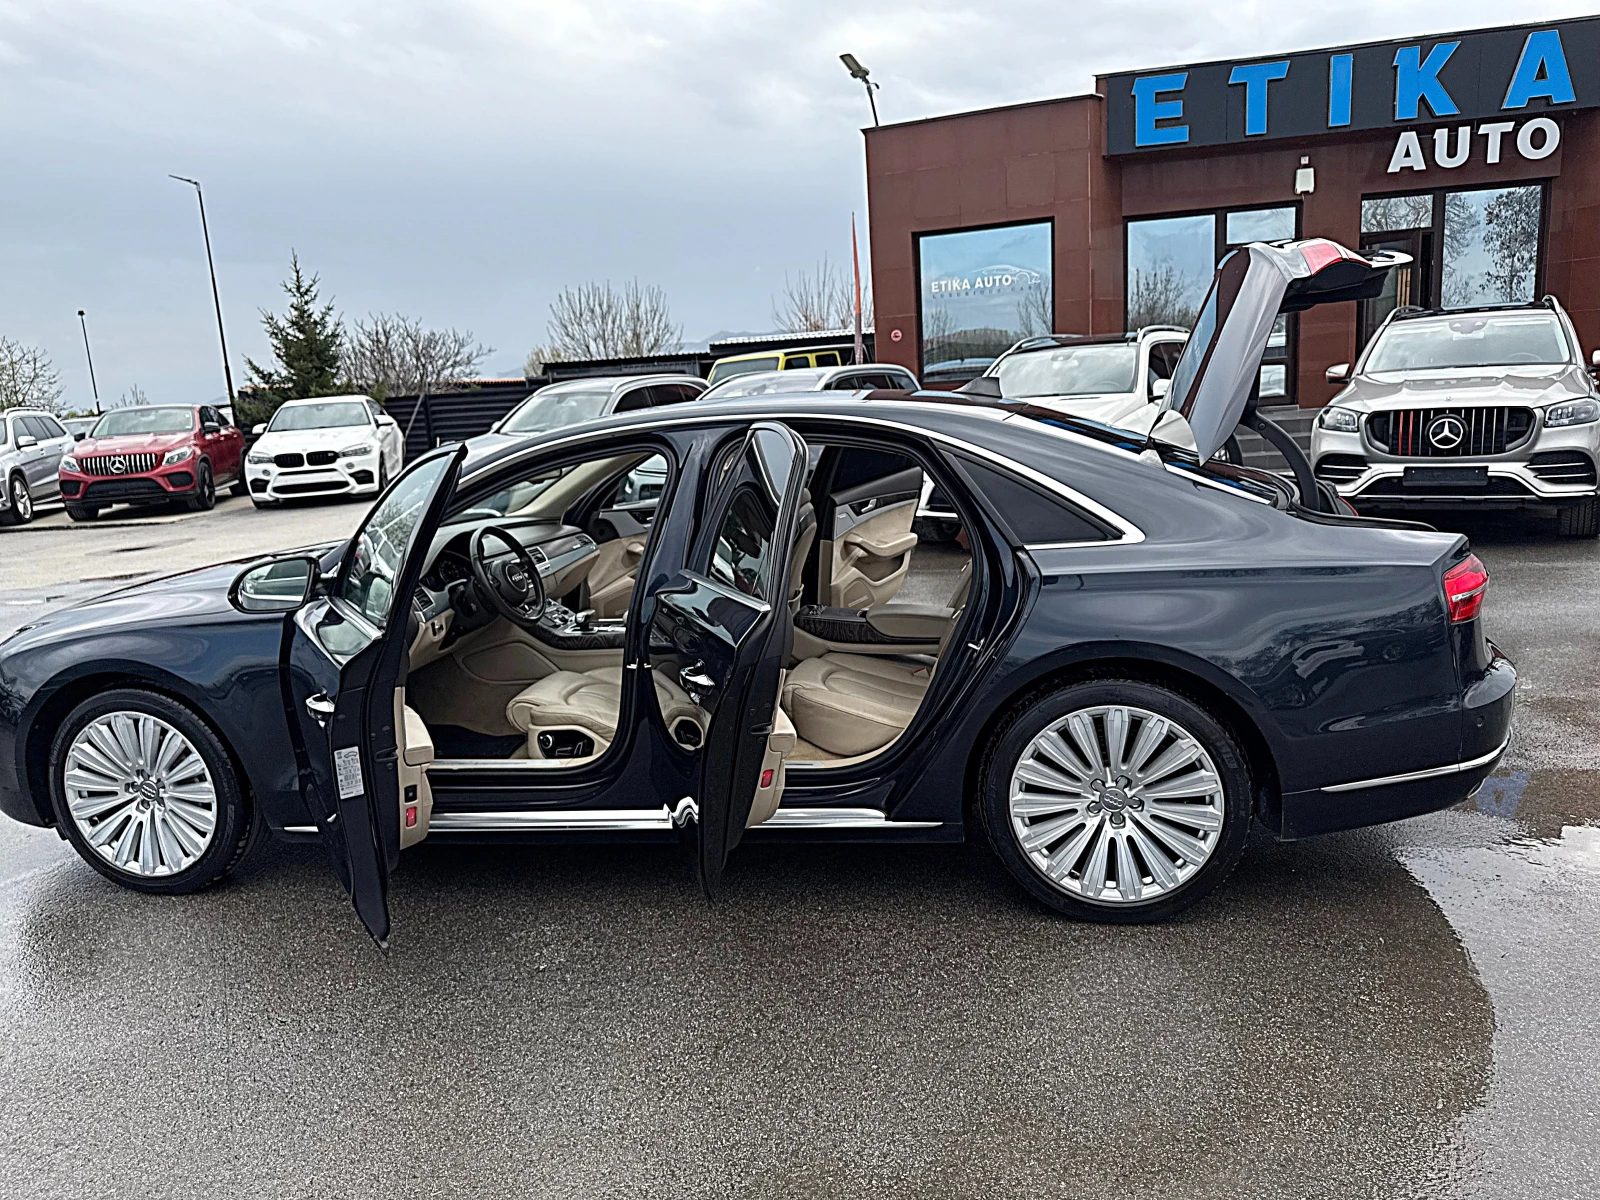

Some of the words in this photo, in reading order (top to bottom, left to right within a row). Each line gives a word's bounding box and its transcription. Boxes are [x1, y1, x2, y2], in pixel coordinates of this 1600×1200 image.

[1131, 30, 1576, 147] ETIKA
[1387, 117, 1561, 173] AUTO
[931, 278, 970, 292] ETIKA
[974, 274, 1012, 288] AUTO
